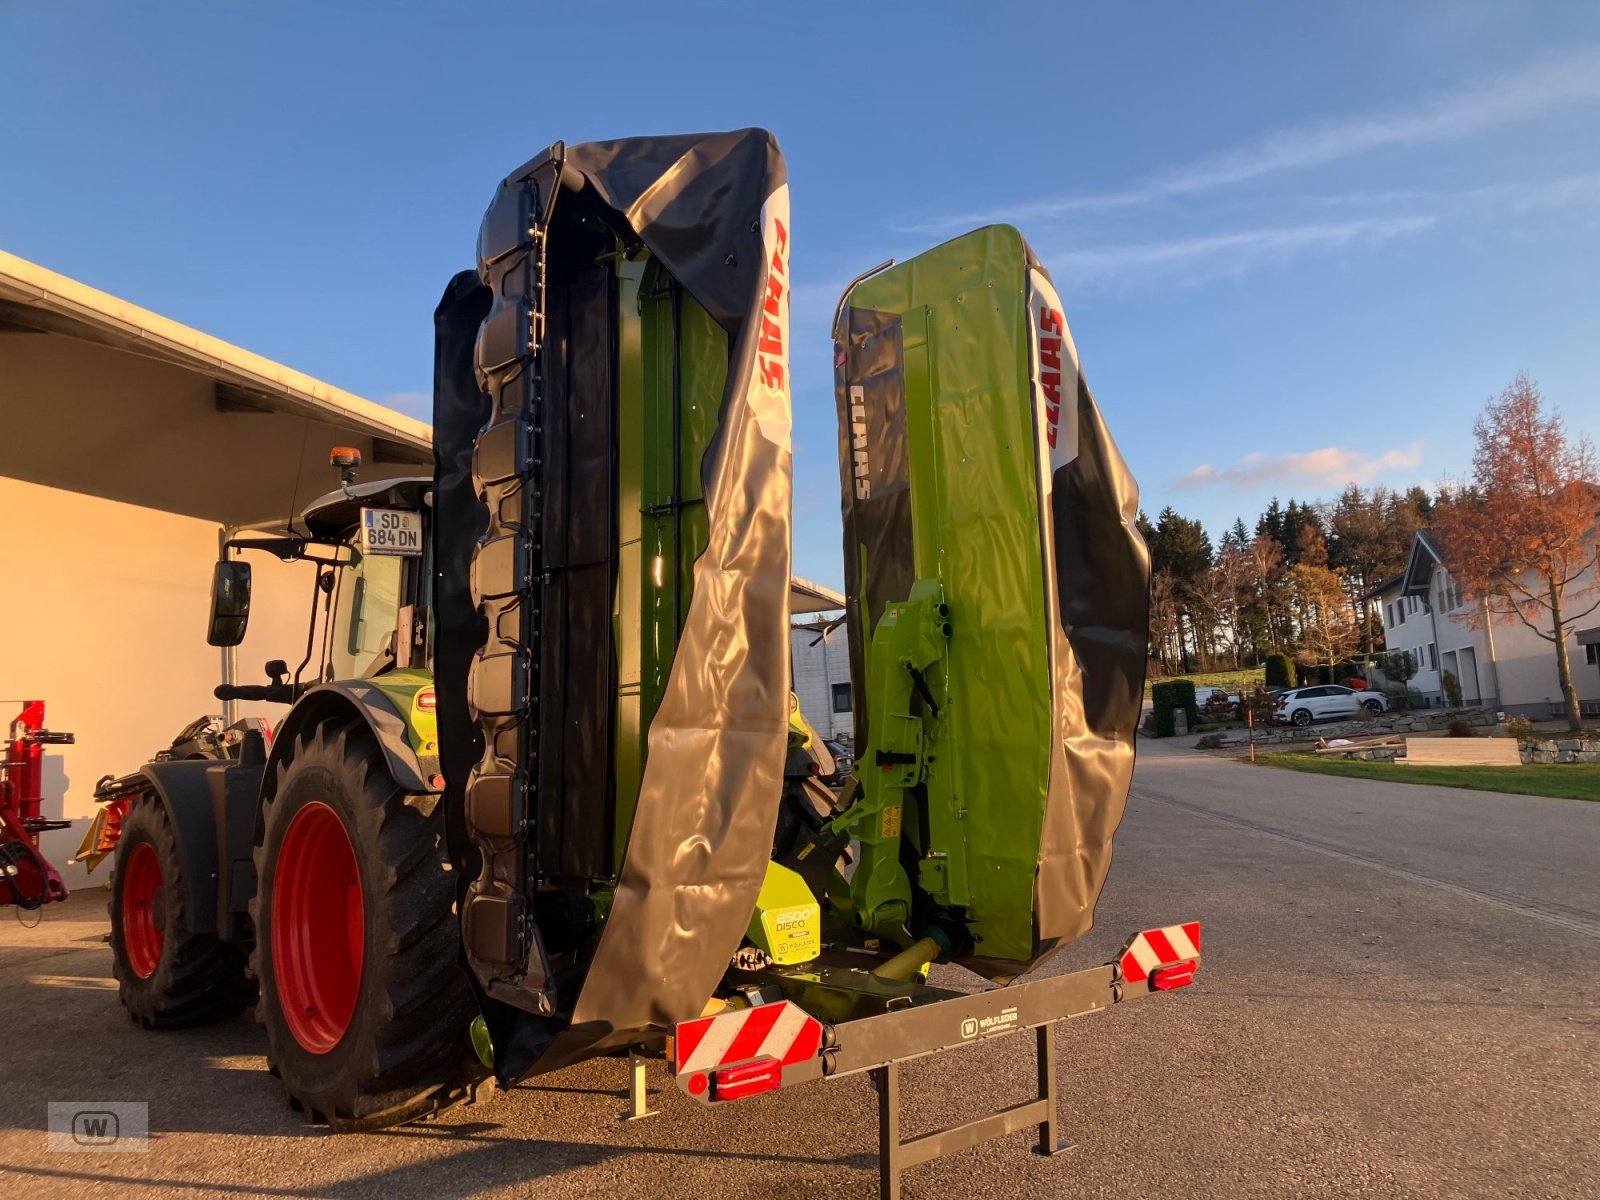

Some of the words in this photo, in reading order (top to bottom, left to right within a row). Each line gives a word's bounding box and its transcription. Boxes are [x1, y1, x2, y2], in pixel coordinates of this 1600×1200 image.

[758, 217, 787, 392] CLAAS
[1040, 306, 1063, 449] CLAAS
[850, 385, 871, 500] CLAAS
[381, 513, 400, 529] SD
[368, 529, 395, 545] 684
[398, 531, 417, 547] DN
[776, 920, 805, 932] DISCO
[980, 1012, 1018, 1028] WÖLFLEDER
